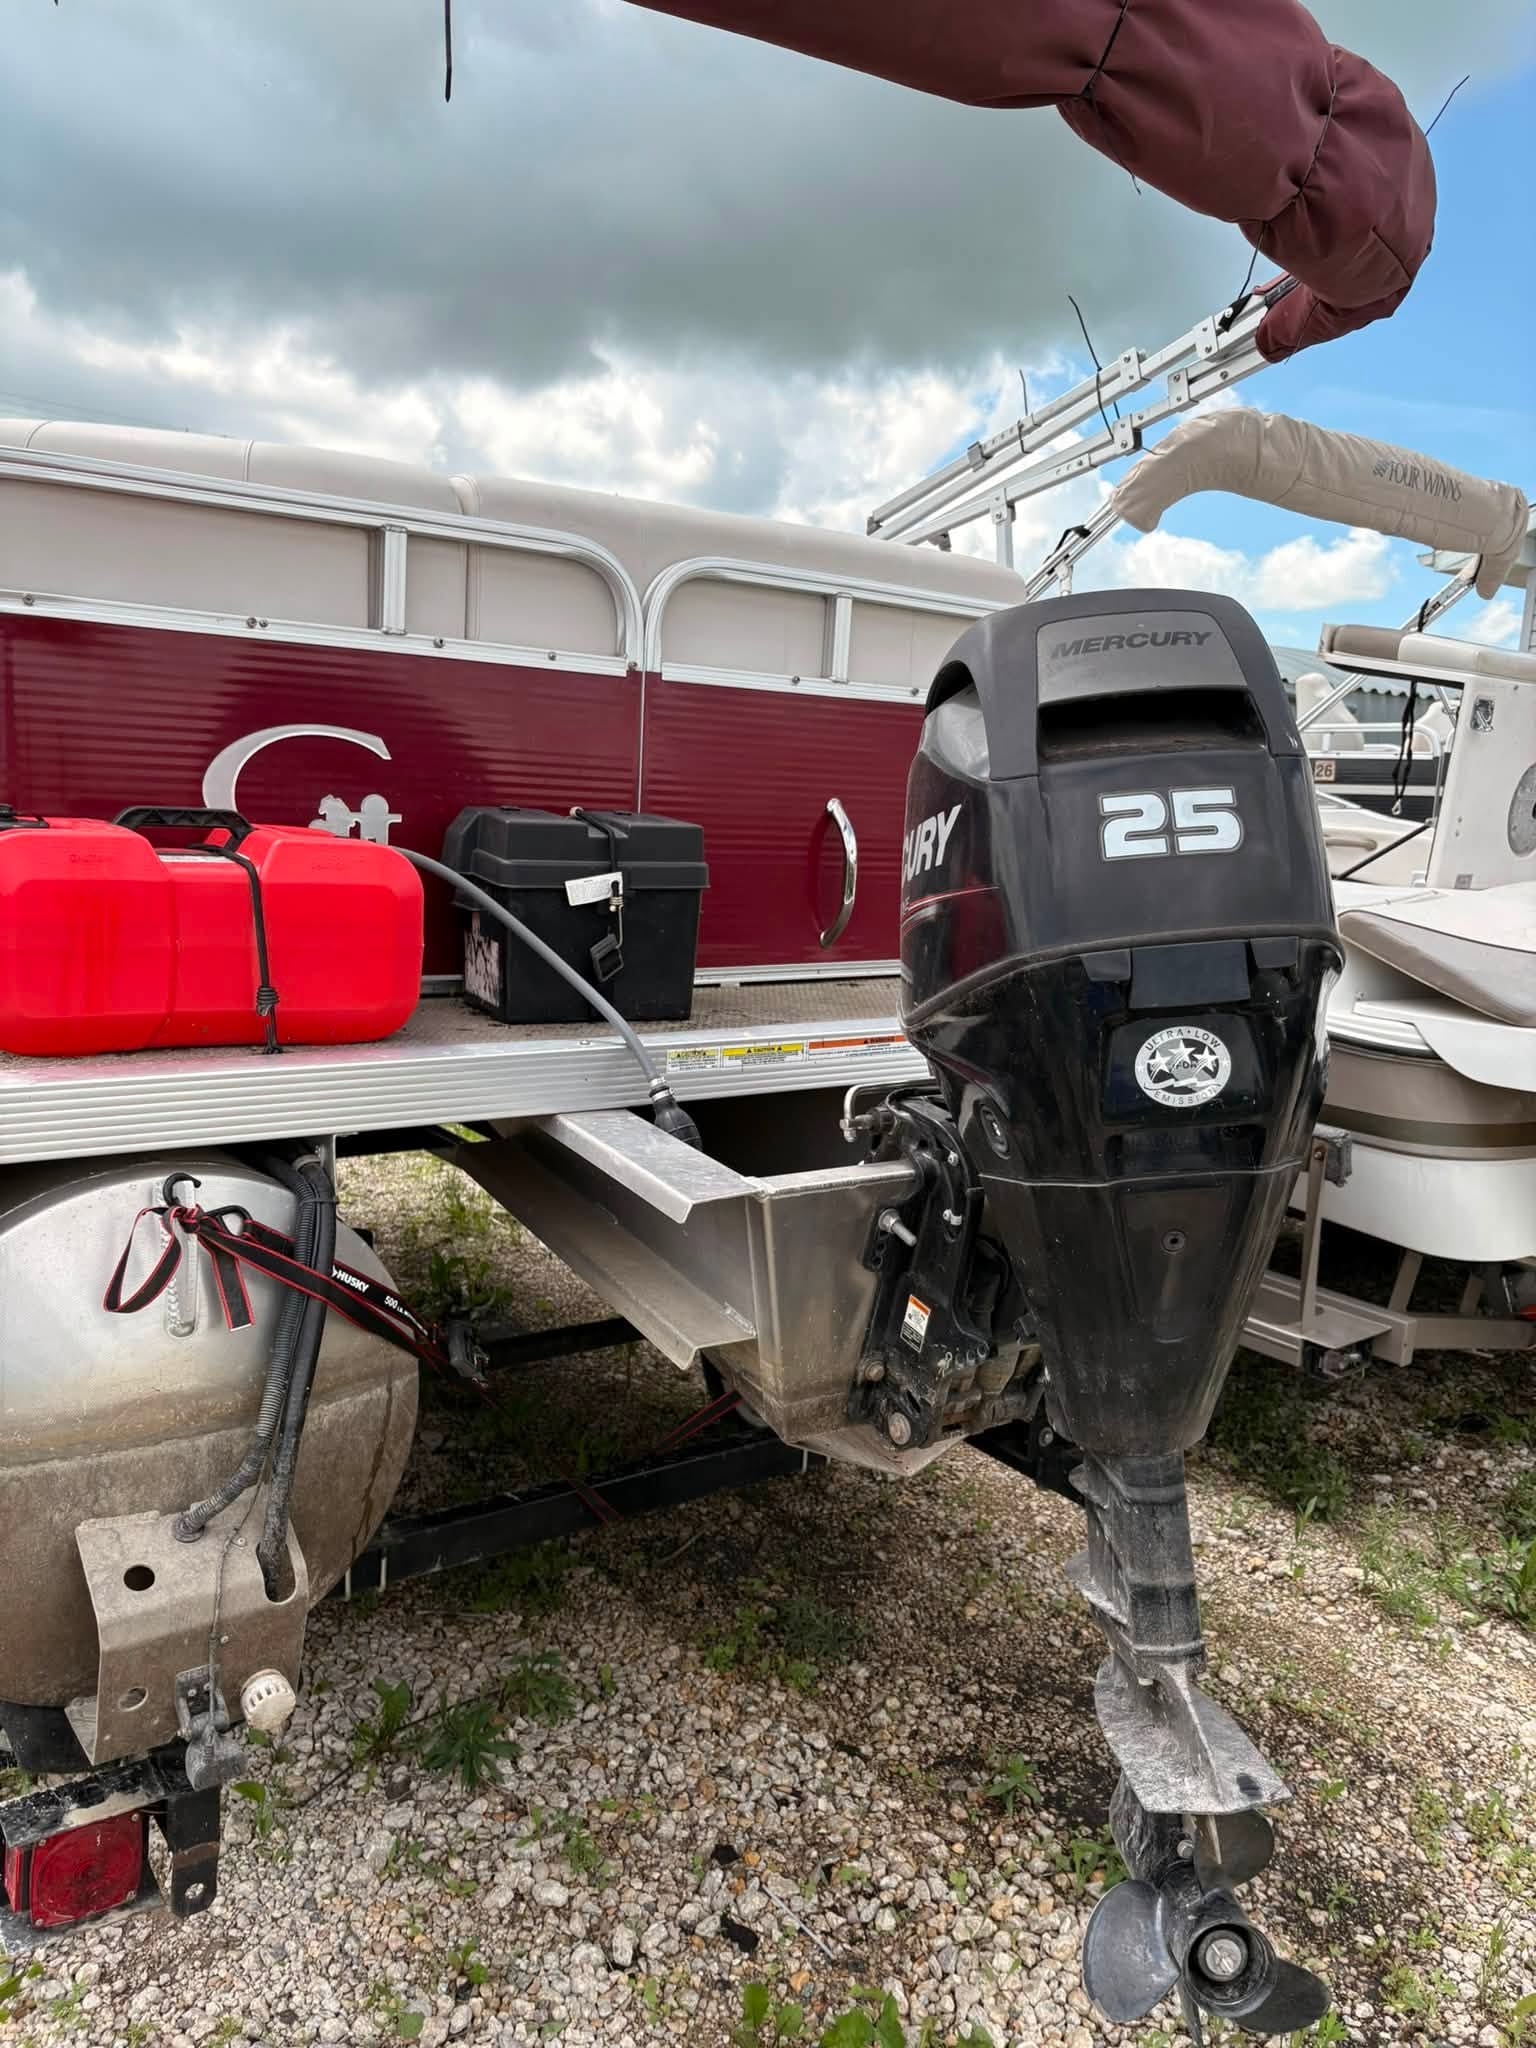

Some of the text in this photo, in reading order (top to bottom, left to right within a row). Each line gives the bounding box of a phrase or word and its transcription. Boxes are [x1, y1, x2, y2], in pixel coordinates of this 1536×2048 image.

[1388, 461, 1463, 503] FOUR WINNS
[1051, 631, 1213, 660] MERCURY
[1315, 763, 1333, 778] 26
[1099, 785, 1245, 861] 25
[1144, 1028, 1221, 1051] ULTRA LOW
[336, 1269, 369, 1292] HUSKY
[384, 1295, 399, 1310] 500
